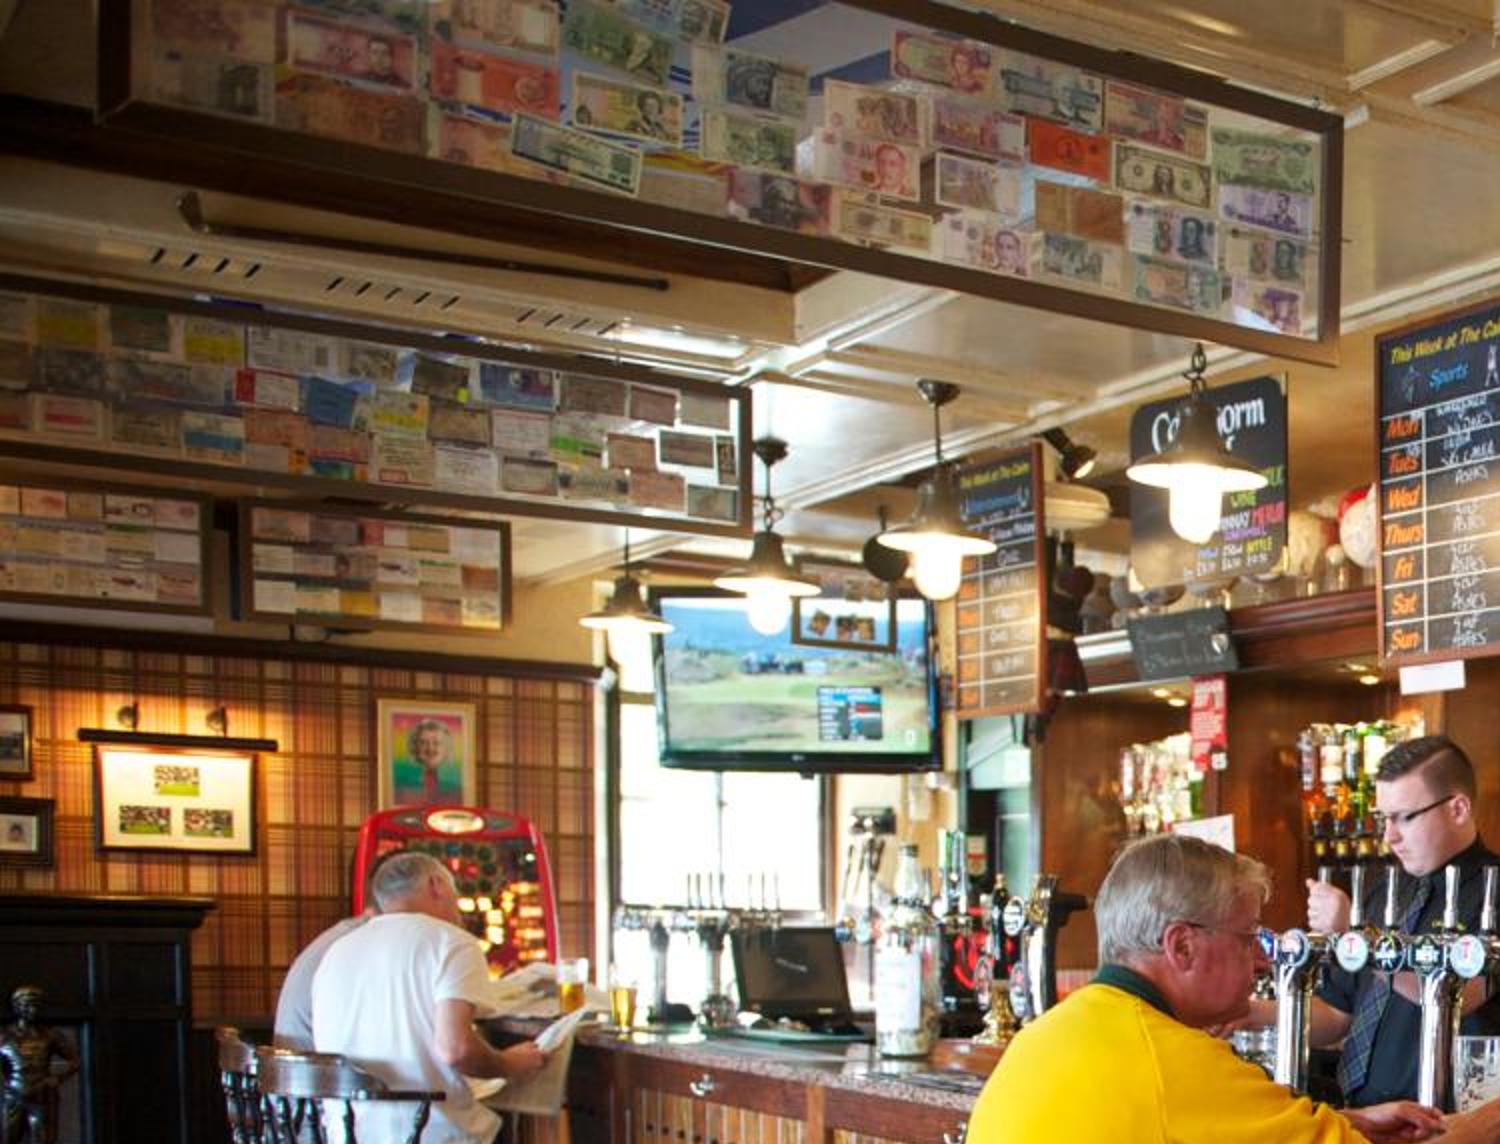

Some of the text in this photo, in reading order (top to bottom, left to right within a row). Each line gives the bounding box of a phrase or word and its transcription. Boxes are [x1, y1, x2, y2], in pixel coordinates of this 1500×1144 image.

[1391, 345, 1413, 365] This
[1460, 325, 1481, 347] The
[1386, 416, 1419, 439] Mon
[1388, 451, 1419, 475] Tues
[1388, 485, 1420, 511] Wed
[1384, 522, 1425, 546] Thurs
[1394, 554, 1415, 580] Fri
[1391, 591, 1418, 616] Sat
[1391, 628, 1420, 651] Sun
